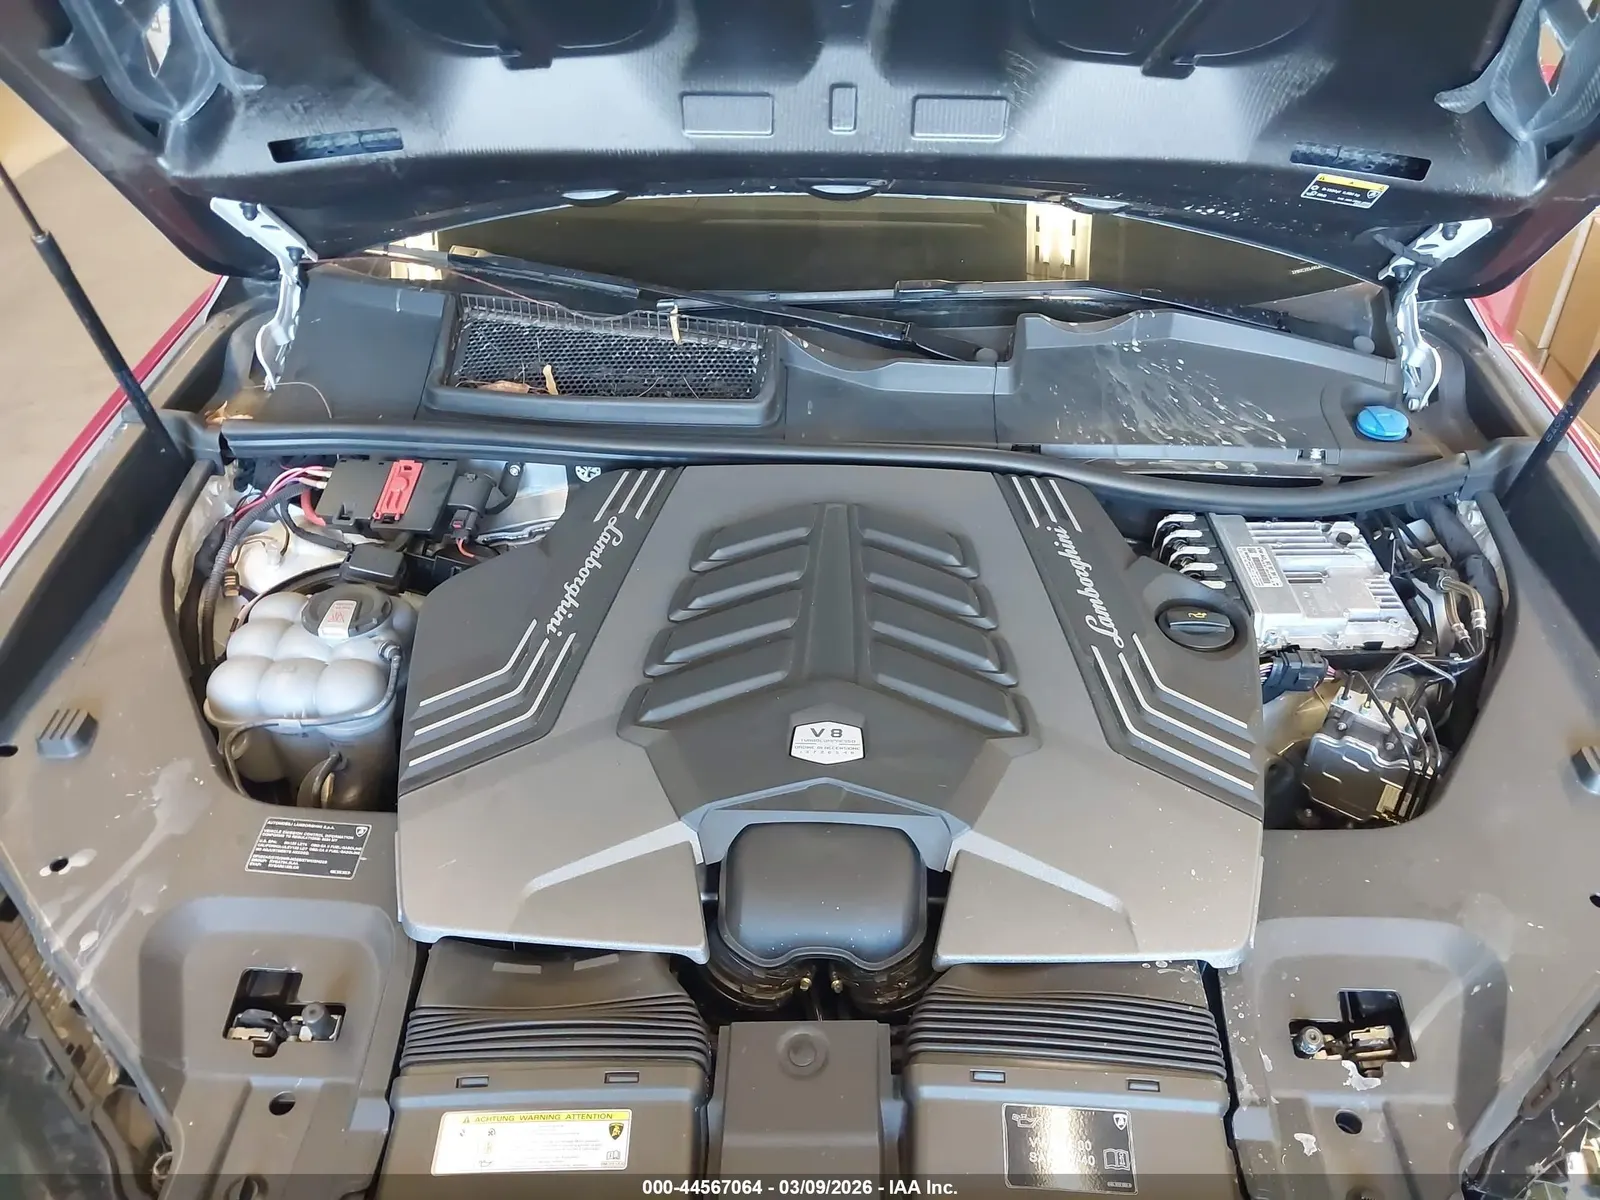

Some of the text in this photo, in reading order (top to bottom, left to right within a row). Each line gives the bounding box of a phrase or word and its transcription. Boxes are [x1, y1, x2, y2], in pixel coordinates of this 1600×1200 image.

[546, 516, 624, 637] Lamborghini
[1046, 525, 1124, 648] Lamborghini
[475, 1112, 613, 1123] ACHTUNG WARNING ATTENTION
